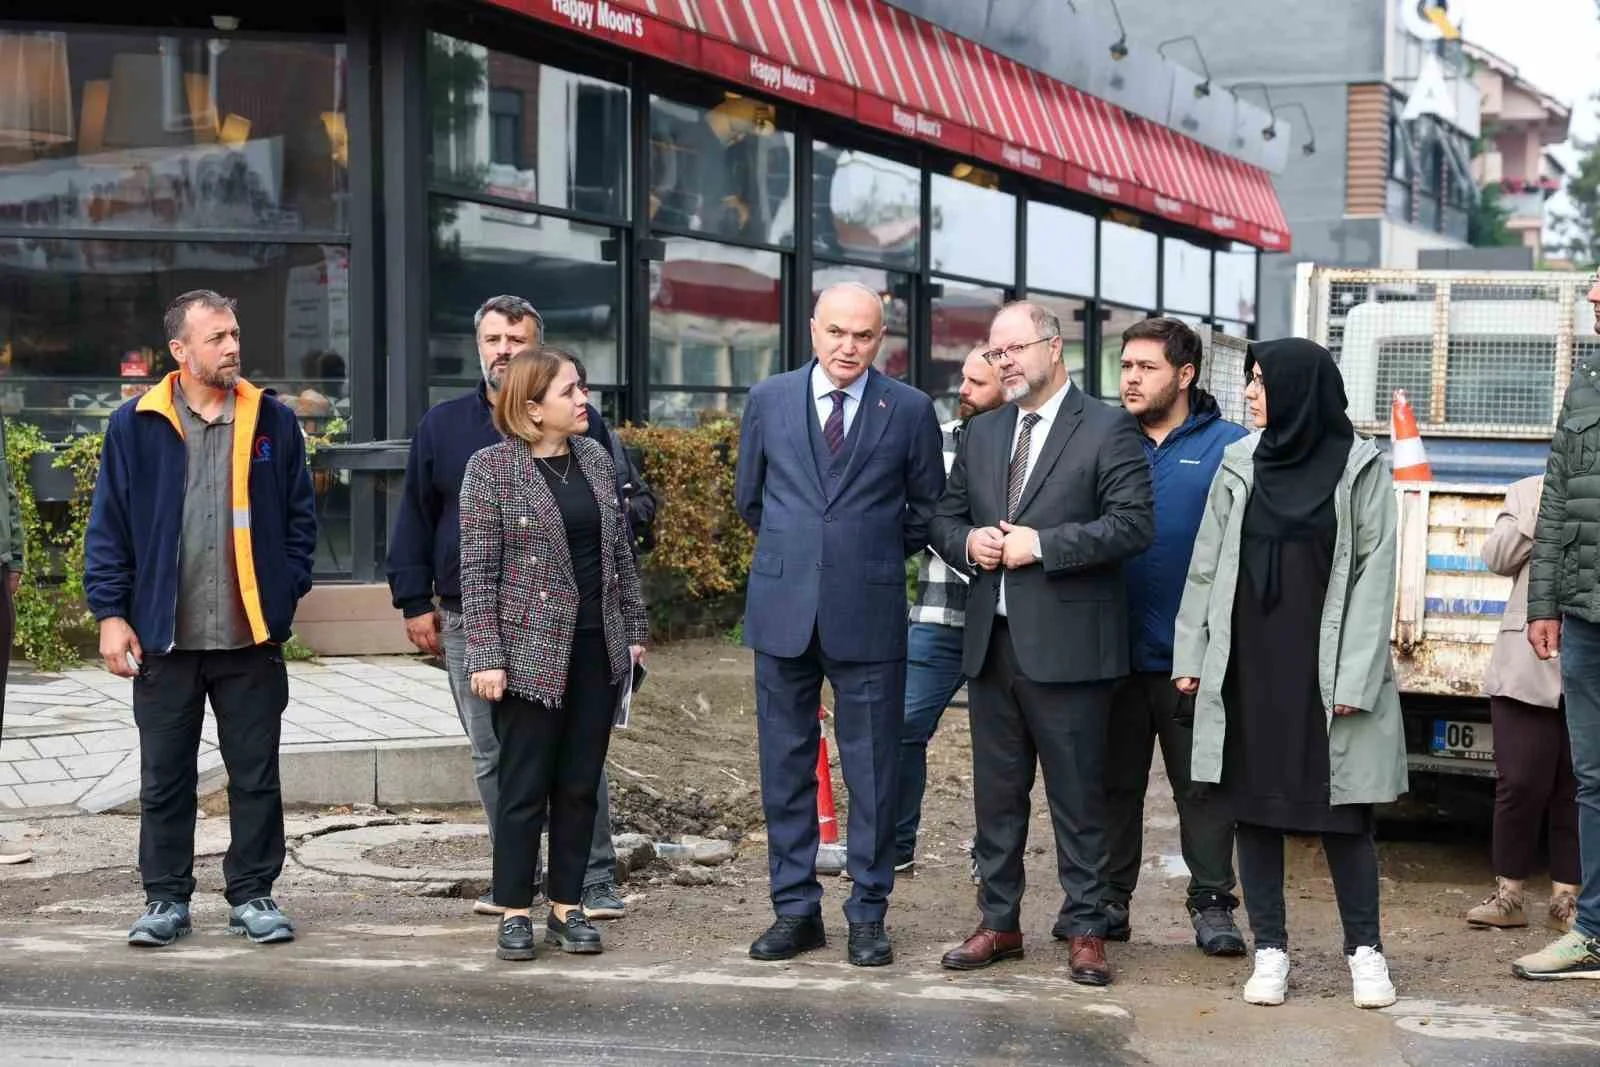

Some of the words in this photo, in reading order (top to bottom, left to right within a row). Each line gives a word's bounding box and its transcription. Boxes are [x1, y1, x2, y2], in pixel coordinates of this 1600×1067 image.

[597, 0, 643, 37] Moon's
[751, 54, 781, 90] Happy
[782, 64, 816, 95] Moon's
[1447, 724, 1473, 748] 06
